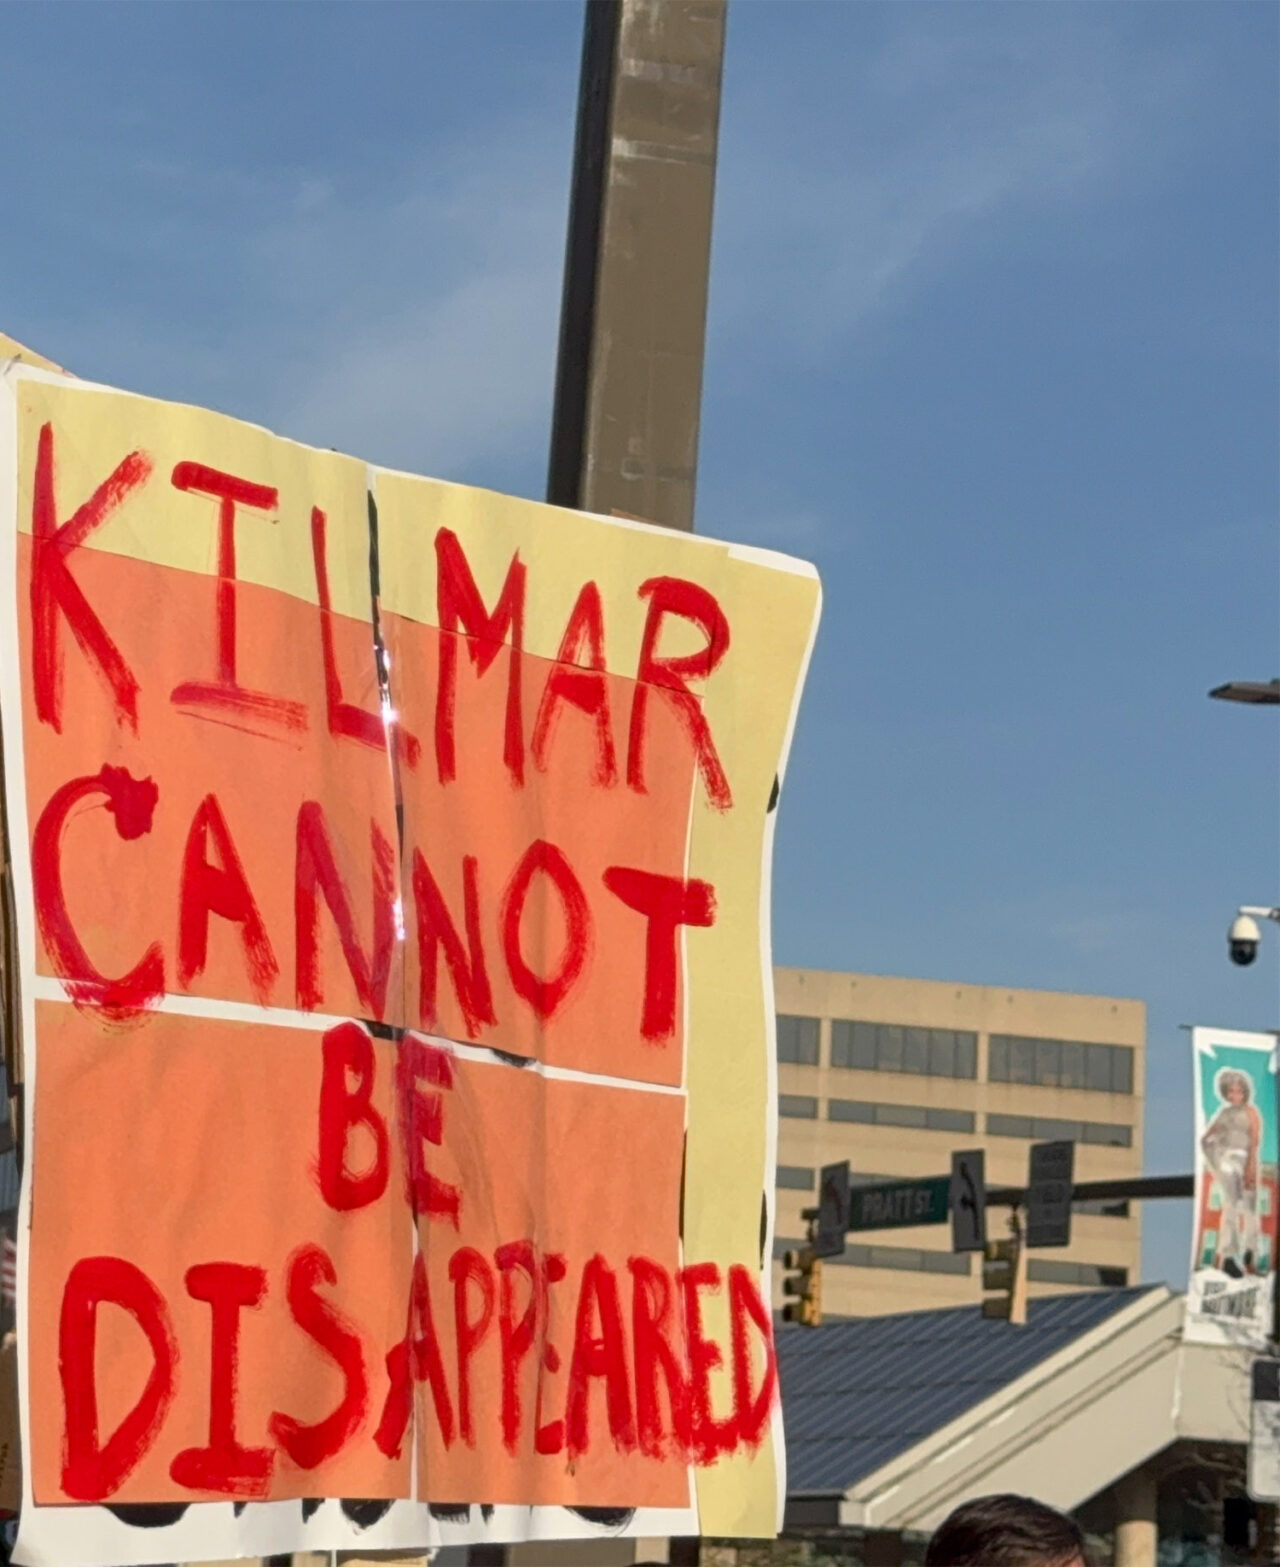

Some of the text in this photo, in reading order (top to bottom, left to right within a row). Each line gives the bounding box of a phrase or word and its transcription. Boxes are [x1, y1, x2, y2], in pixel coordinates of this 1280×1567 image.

[29, 421, 733, 813] KILMAR
[31, 762, 716, 1044] CANNOT
[317, 1020, 460, 1230] BE
[59, 1238, 776, 1502] DISAPPEARED
